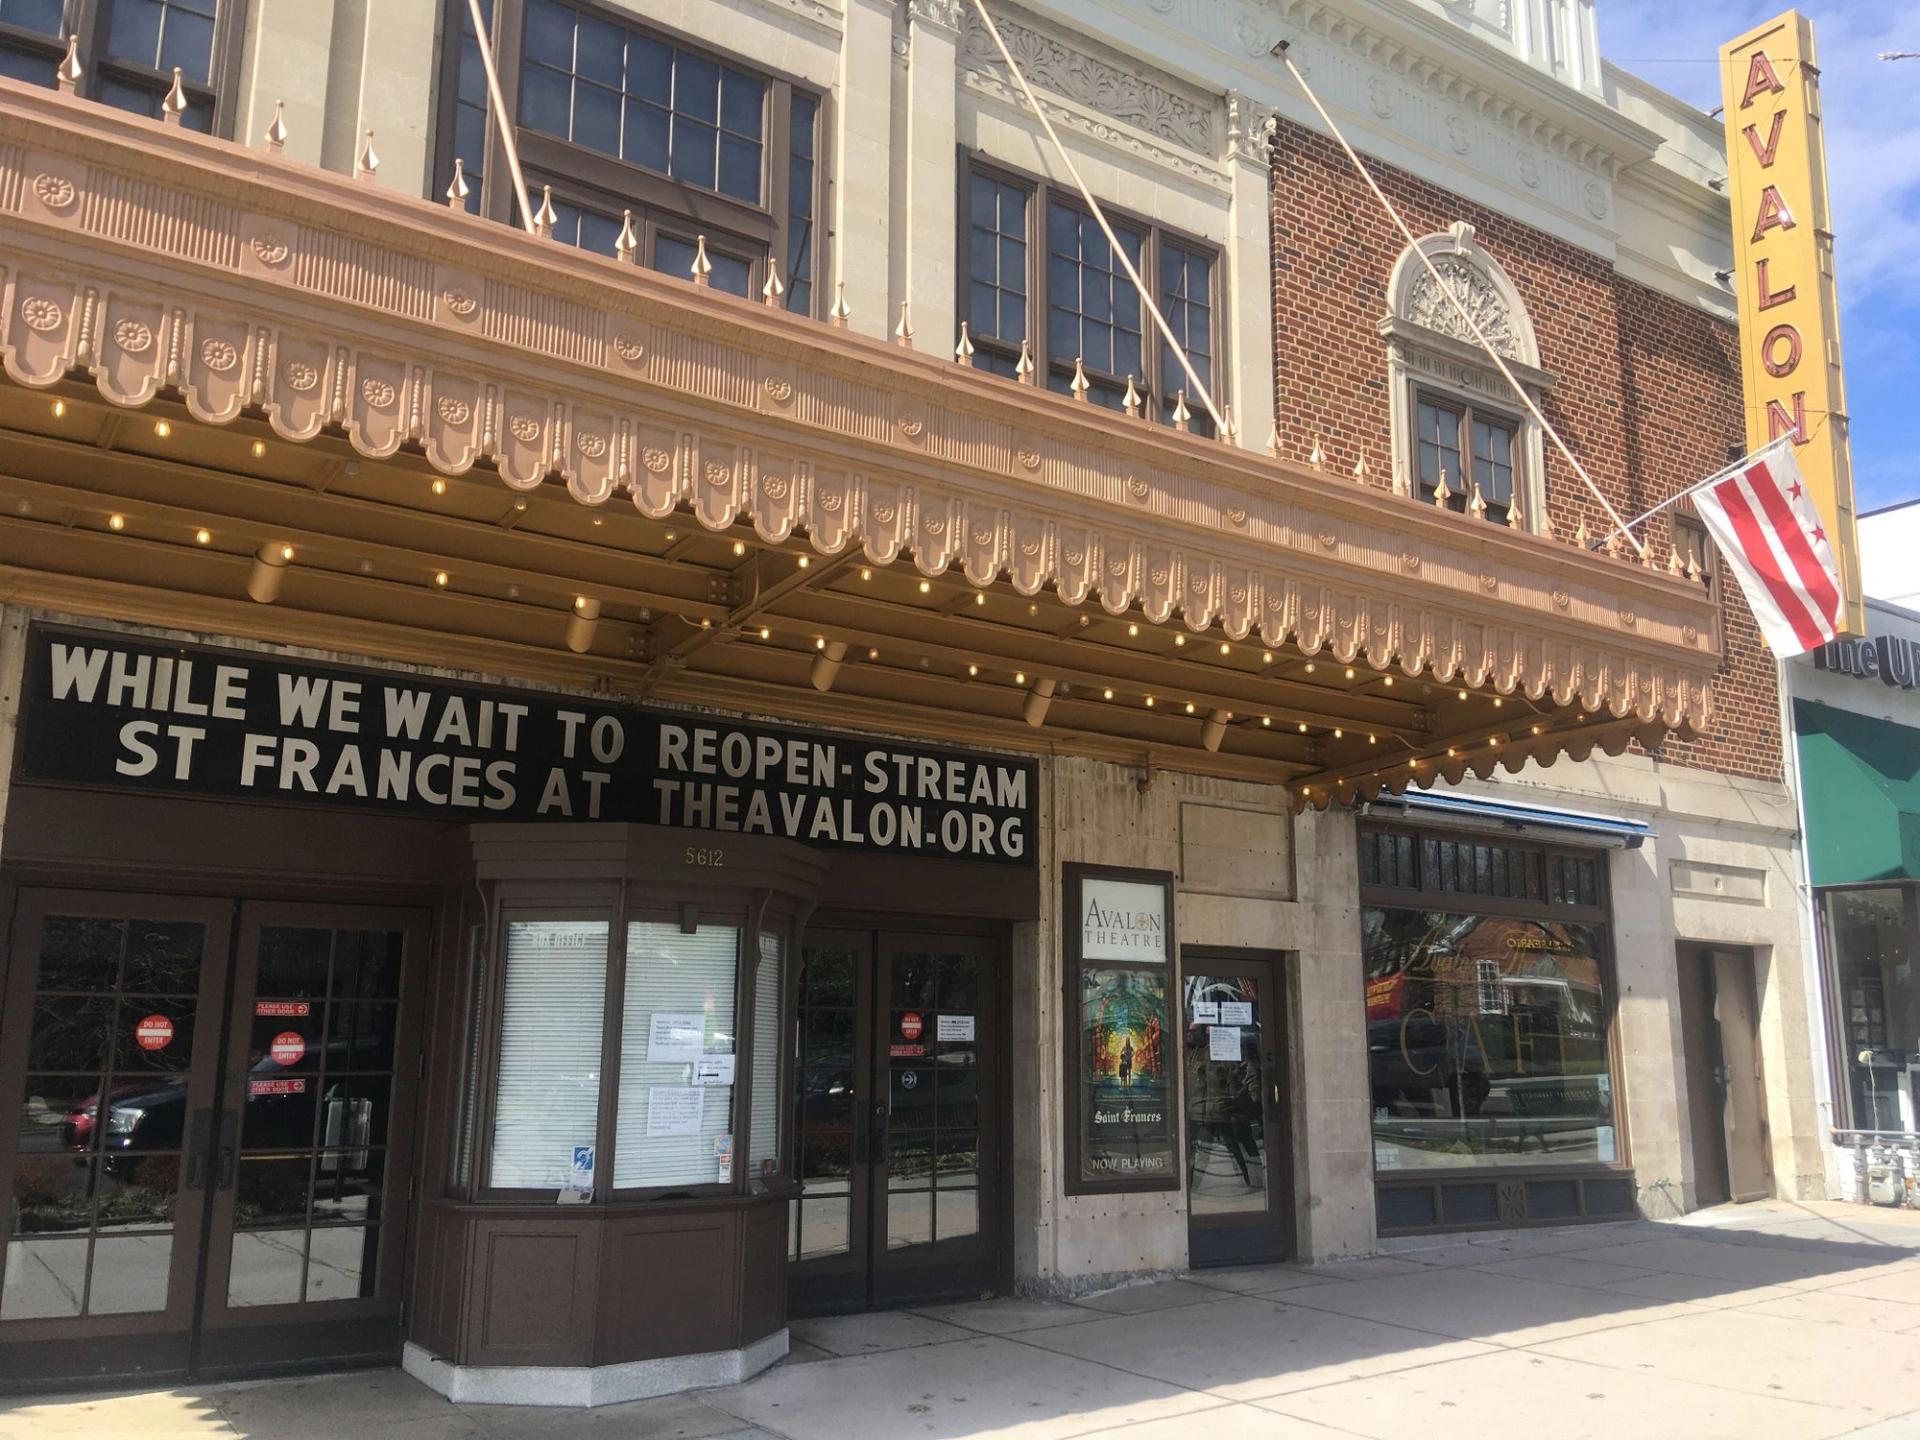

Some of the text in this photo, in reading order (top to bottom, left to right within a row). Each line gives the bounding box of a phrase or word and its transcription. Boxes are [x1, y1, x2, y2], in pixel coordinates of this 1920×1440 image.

[1739, 50, 1808, 449] AVALON
[51, 643, 249, 721] WHILE
[278, 673, 362, 734] WE
[384, 687, 529, 752] WAIT
[557, 710, 624, 763] TO
[116, 720, 206, 781] ST
[241, 733, 517, 811] FRANCES
[536, 767, 611, 819] AT
[685, 847, 723, 867] 5612
[1084, 930, 1162, 948] THEATRE
[144, 1020, 169, 1028] DO NOT
[144, 1036, 164, 1045] ENTER
[277, 1037, 301, 1045] DO NOT
[277, 1052, 297, 1060] ENTER
[1094, 1105, 1162, 1124] Saint Frances
[1092, 1155, 1162, 1169] NOW PLAYING
